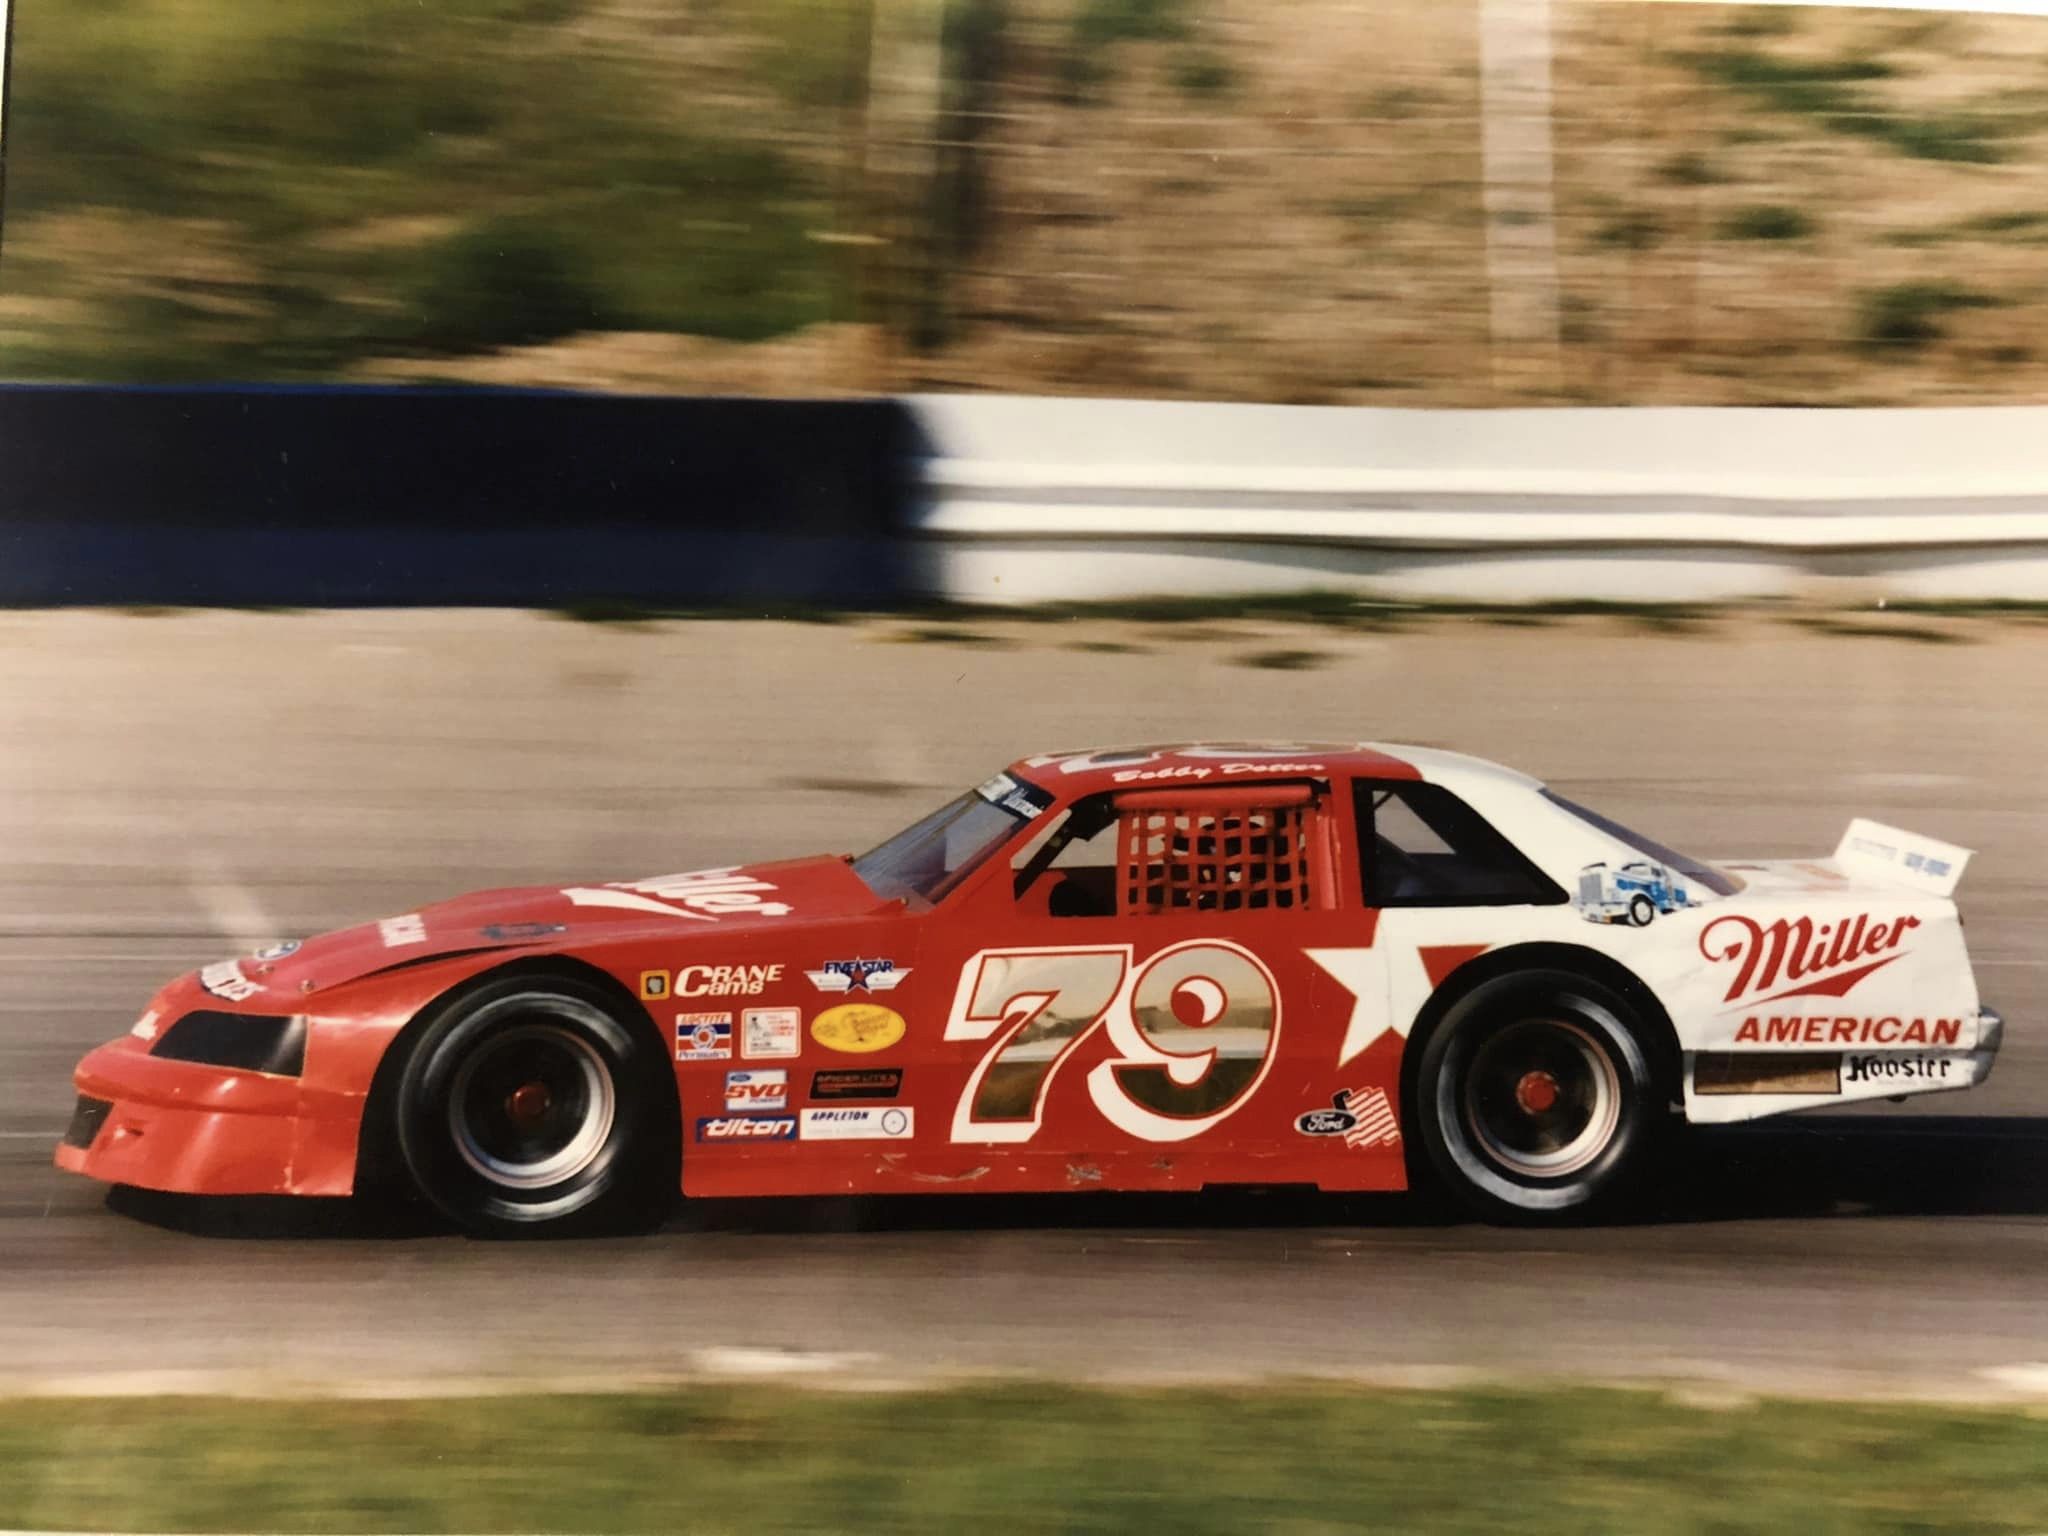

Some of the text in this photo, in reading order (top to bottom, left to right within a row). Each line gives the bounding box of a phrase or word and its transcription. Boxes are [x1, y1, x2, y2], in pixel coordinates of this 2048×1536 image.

[1111, 766, 1213, 782] Bobby
[860, 960, 893, 973] STAR
[1698, 913, 1922, 1003] Miller
[674, 964, 786, 997] CRANE
[943, 937, 1283, 1144] 79
[1734, 1015, 1963, 1045] AMERICAN
[1845, 1053, 1952, 1081] Hoosier
[724, 1083, 789, 1099] SVO
[810, 1111, 870, 1121] APPLETON
[1306, 1113, 1345, 1132] Ford
